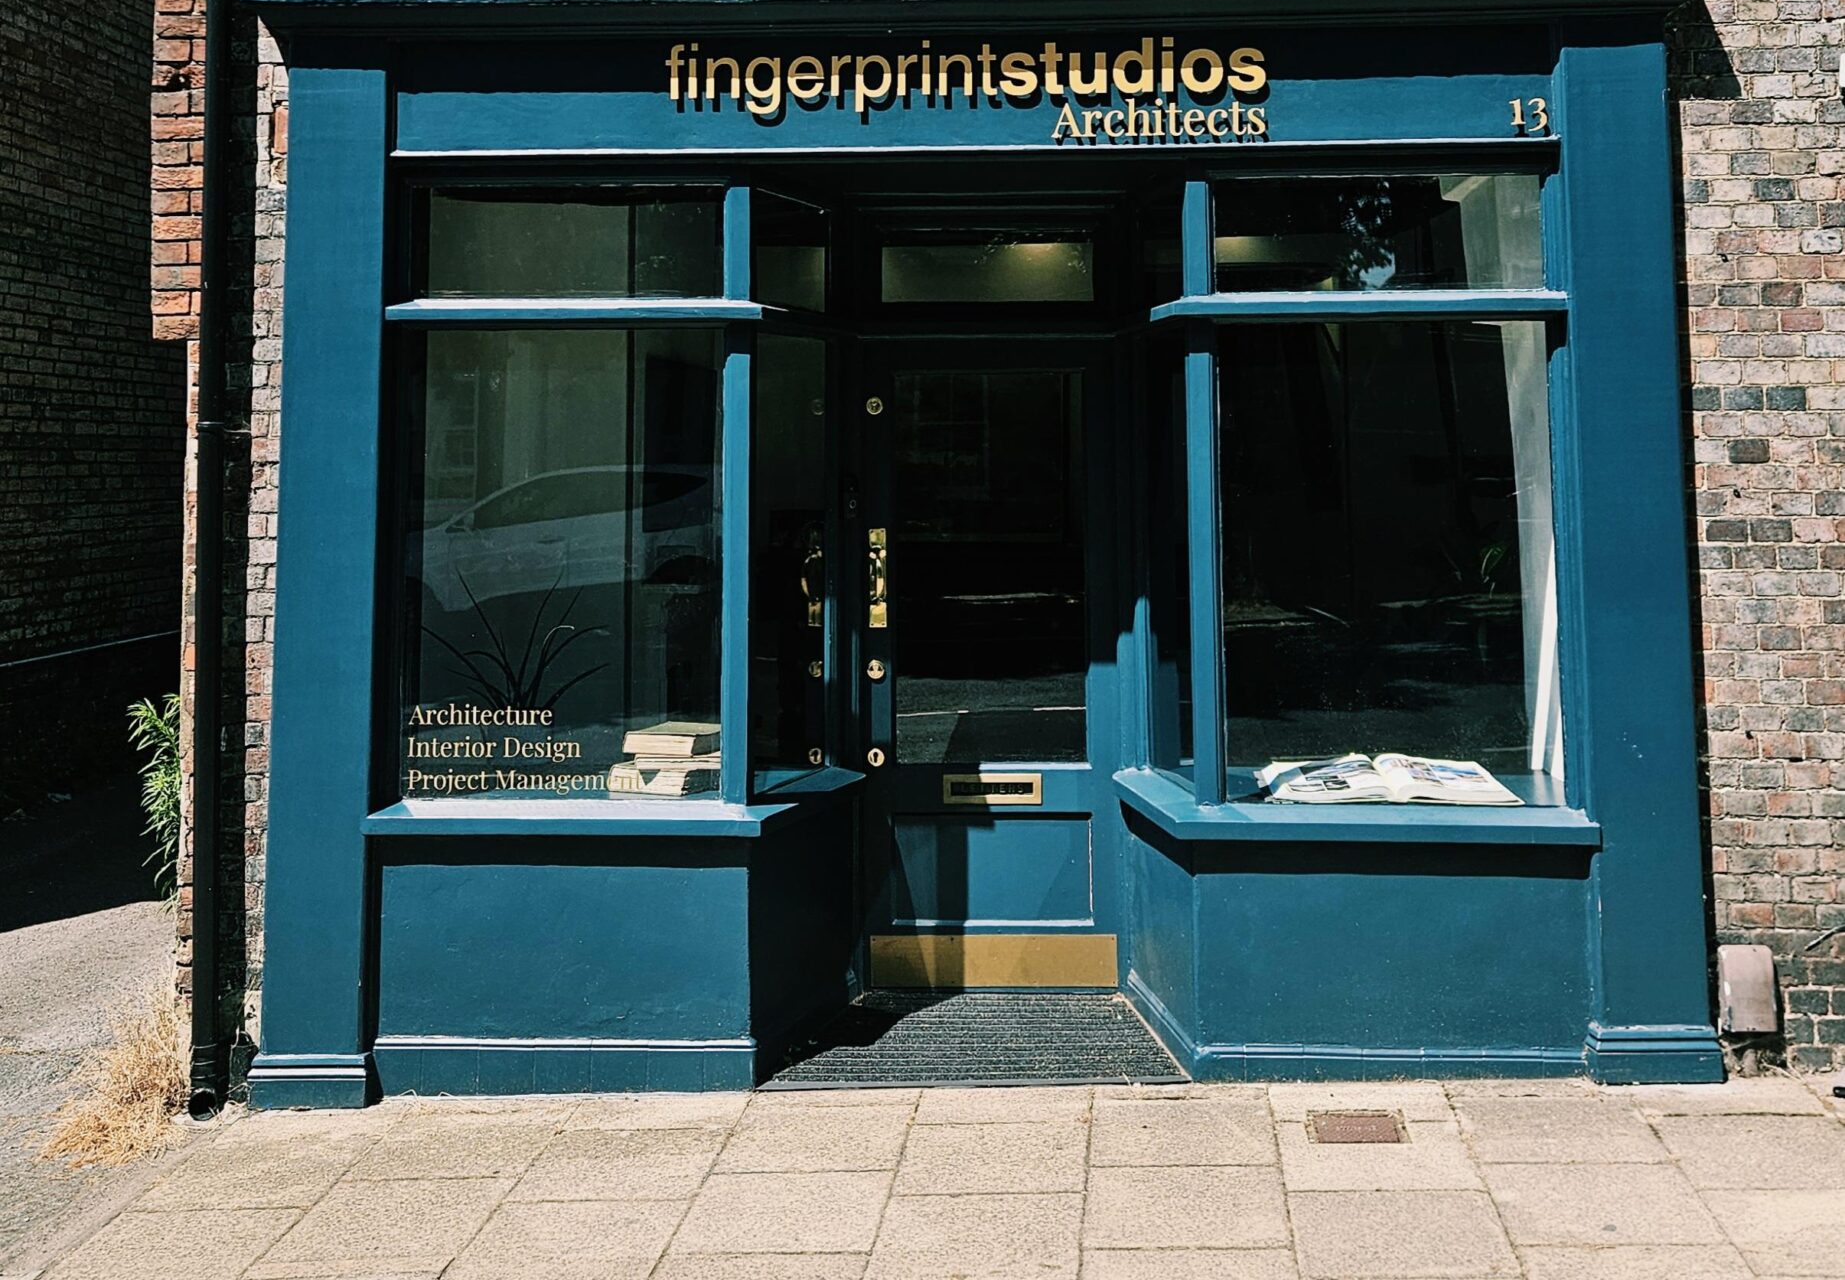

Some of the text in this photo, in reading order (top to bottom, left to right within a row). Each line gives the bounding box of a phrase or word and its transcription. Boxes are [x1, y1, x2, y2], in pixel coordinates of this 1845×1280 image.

[665, 36, 1267, 115] fingerprintstudios
[1050, 98, 1267, 140] Architects
[1508, 97, 1548, 132] 13
[408, 703, 552, 726] Architecture
[407, 735, 581, 763] Interior Design
[407, 768, 489, 795] Project
